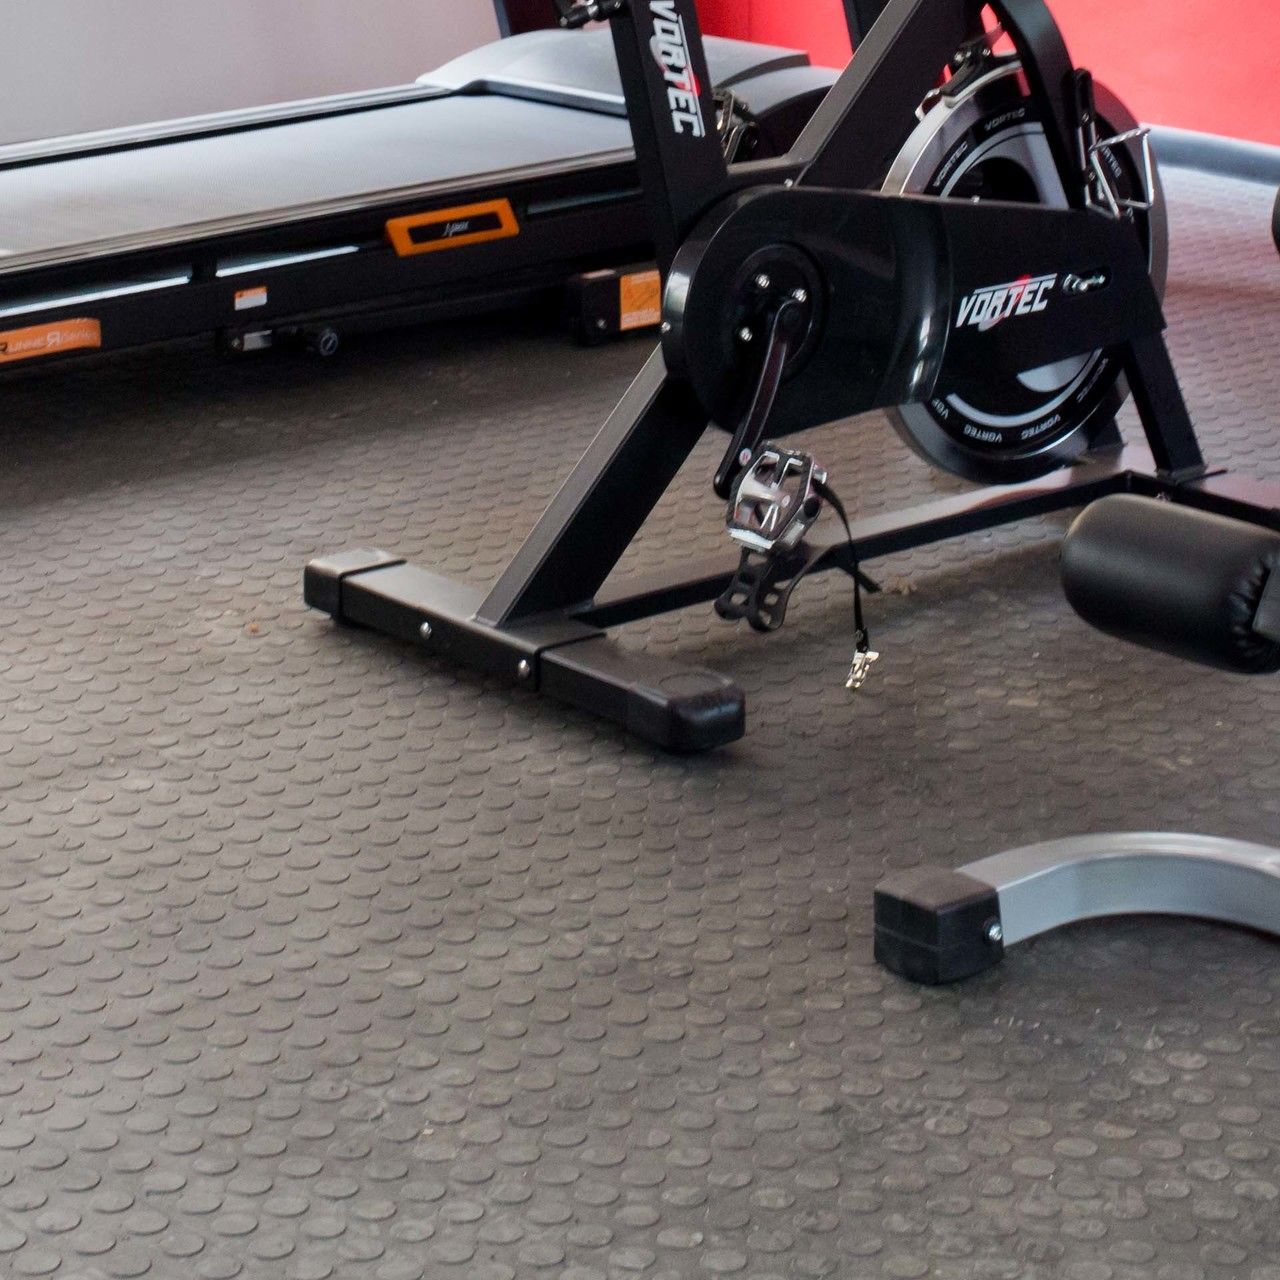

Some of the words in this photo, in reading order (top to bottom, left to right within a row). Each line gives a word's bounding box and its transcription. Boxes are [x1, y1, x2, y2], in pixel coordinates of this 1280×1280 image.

[649, 0, 705, 137] VORTEC
[984, 107, 1025, 131] VORTEC
[933, 141, 968, 187] VORTEC
[955, 273, 1058, 331] VORTEC
[962, 423, 1003, 444] VORTEC
